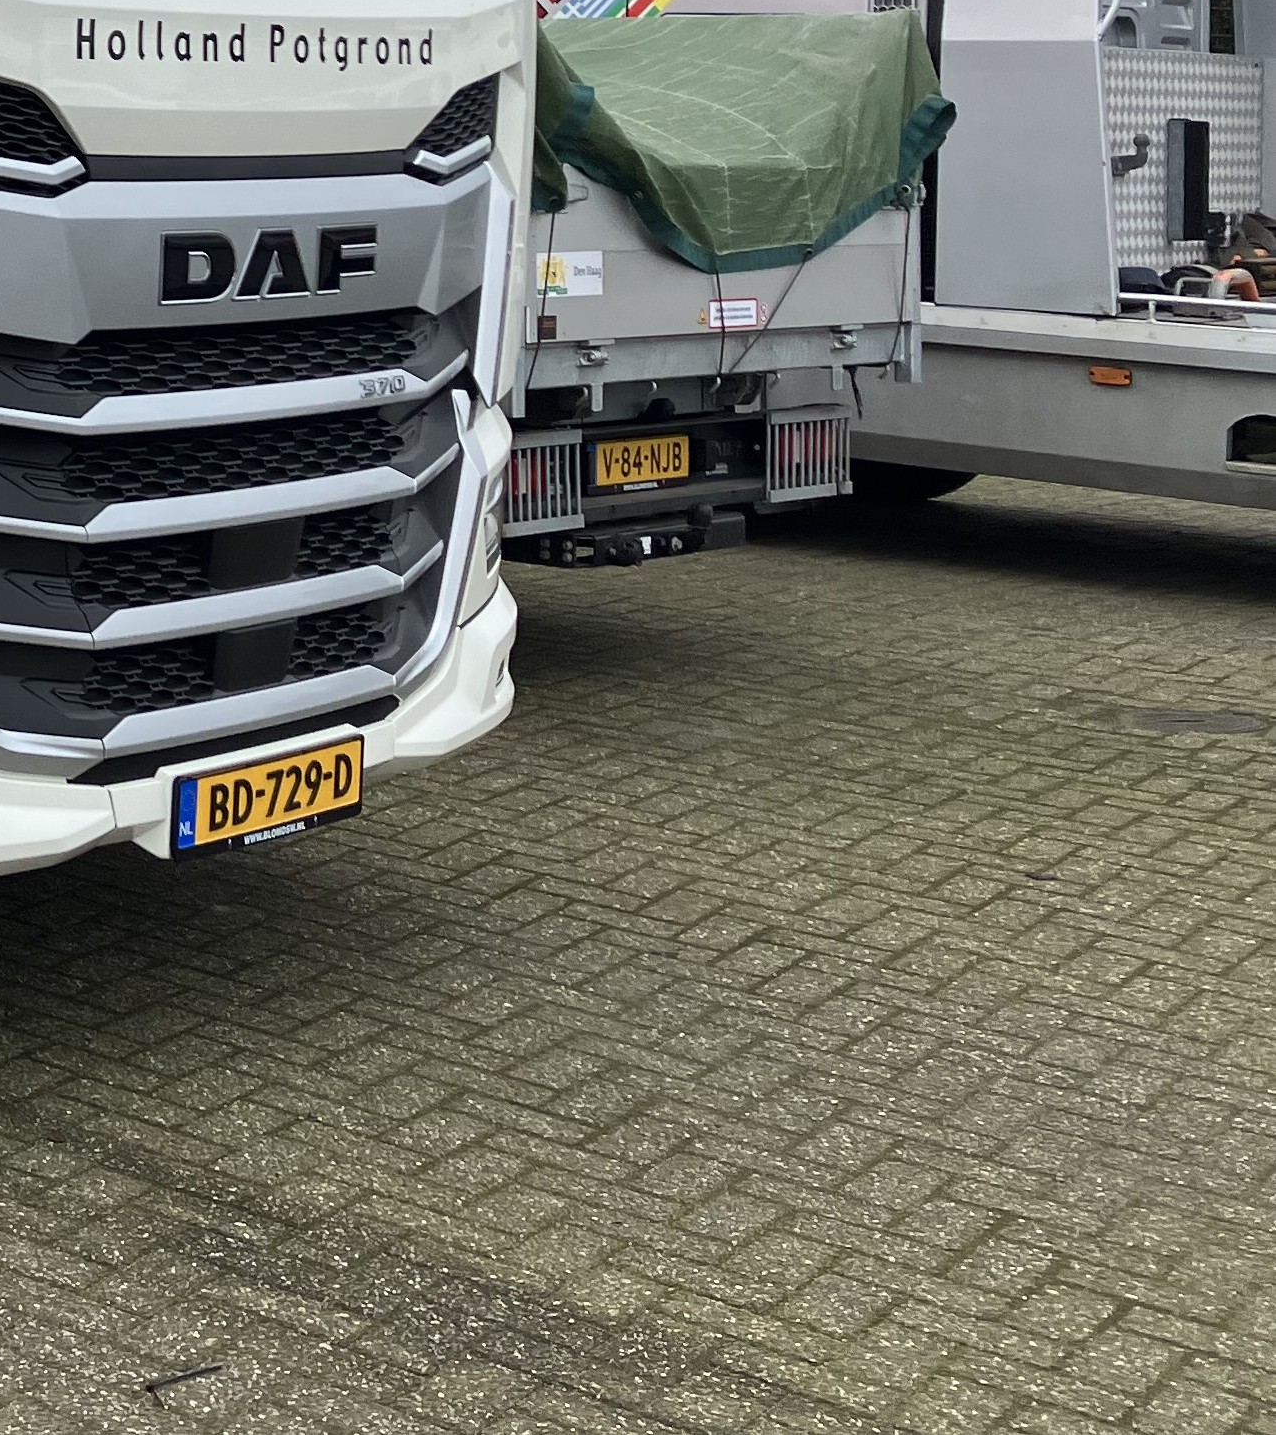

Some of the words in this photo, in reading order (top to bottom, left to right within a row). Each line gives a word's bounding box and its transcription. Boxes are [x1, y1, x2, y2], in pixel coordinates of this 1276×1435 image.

[75, 18, 246, 62] Holland
[270, 24, 433, 72] Potgrond
[158, 222, 379, 306] DAF
[359, 375, 406, 399] 370
[603, 442, 683, 480] V-84-NJB
[209, 753, 353, 833] BD-729-D
[178, 821, 194, 837] NL
